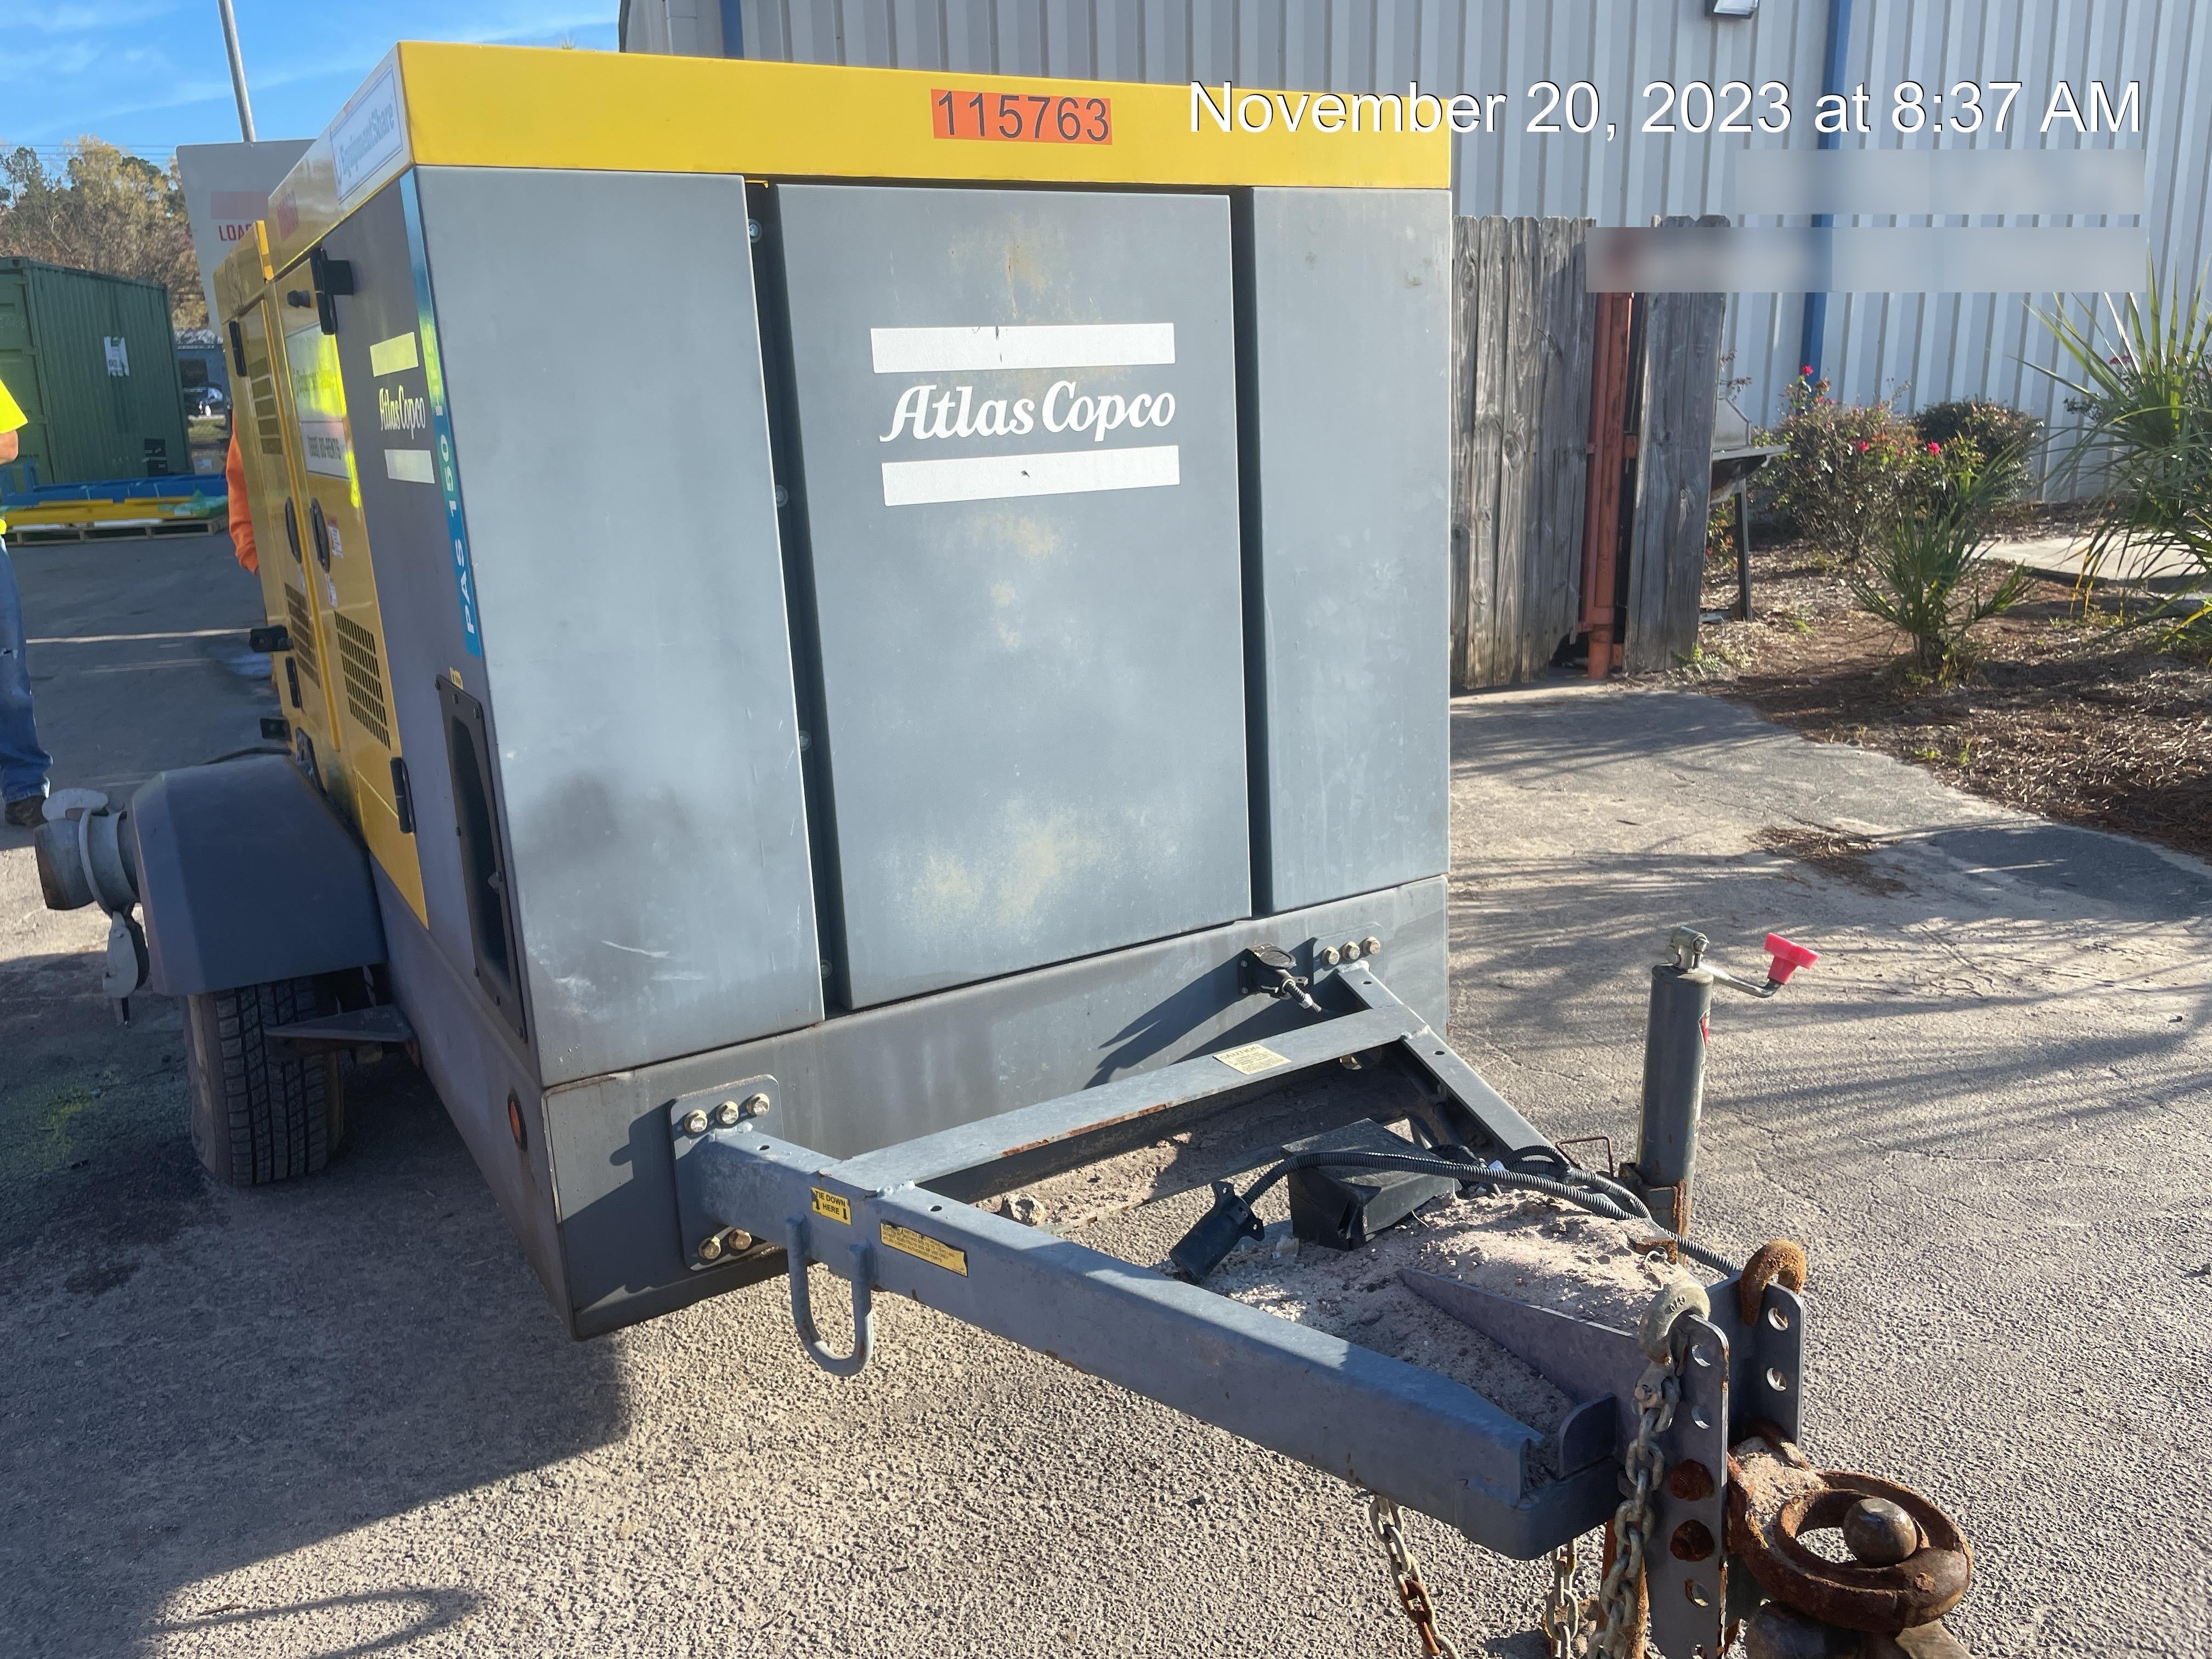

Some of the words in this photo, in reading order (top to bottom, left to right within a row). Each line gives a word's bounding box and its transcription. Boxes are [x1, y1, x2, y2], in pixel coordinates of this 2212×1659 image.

[939, 91, 1108, 141] 115763
[218, 223, 252, 241] LOA
[379, 388, 400, 431] Atlas
[398, 385, 426, 440] Copco
[879, 384, 1035, 442] Atlas
[1042, 380, 1176, 442] Copco
[441, 434, 456, 517] 150
[455, 539, 475, 634] PAS
[815, 1190, 825, 1200] TIE
[826, 1194, 845, 1207] DOWN
[822, 1203, 840, 1215] HERE
